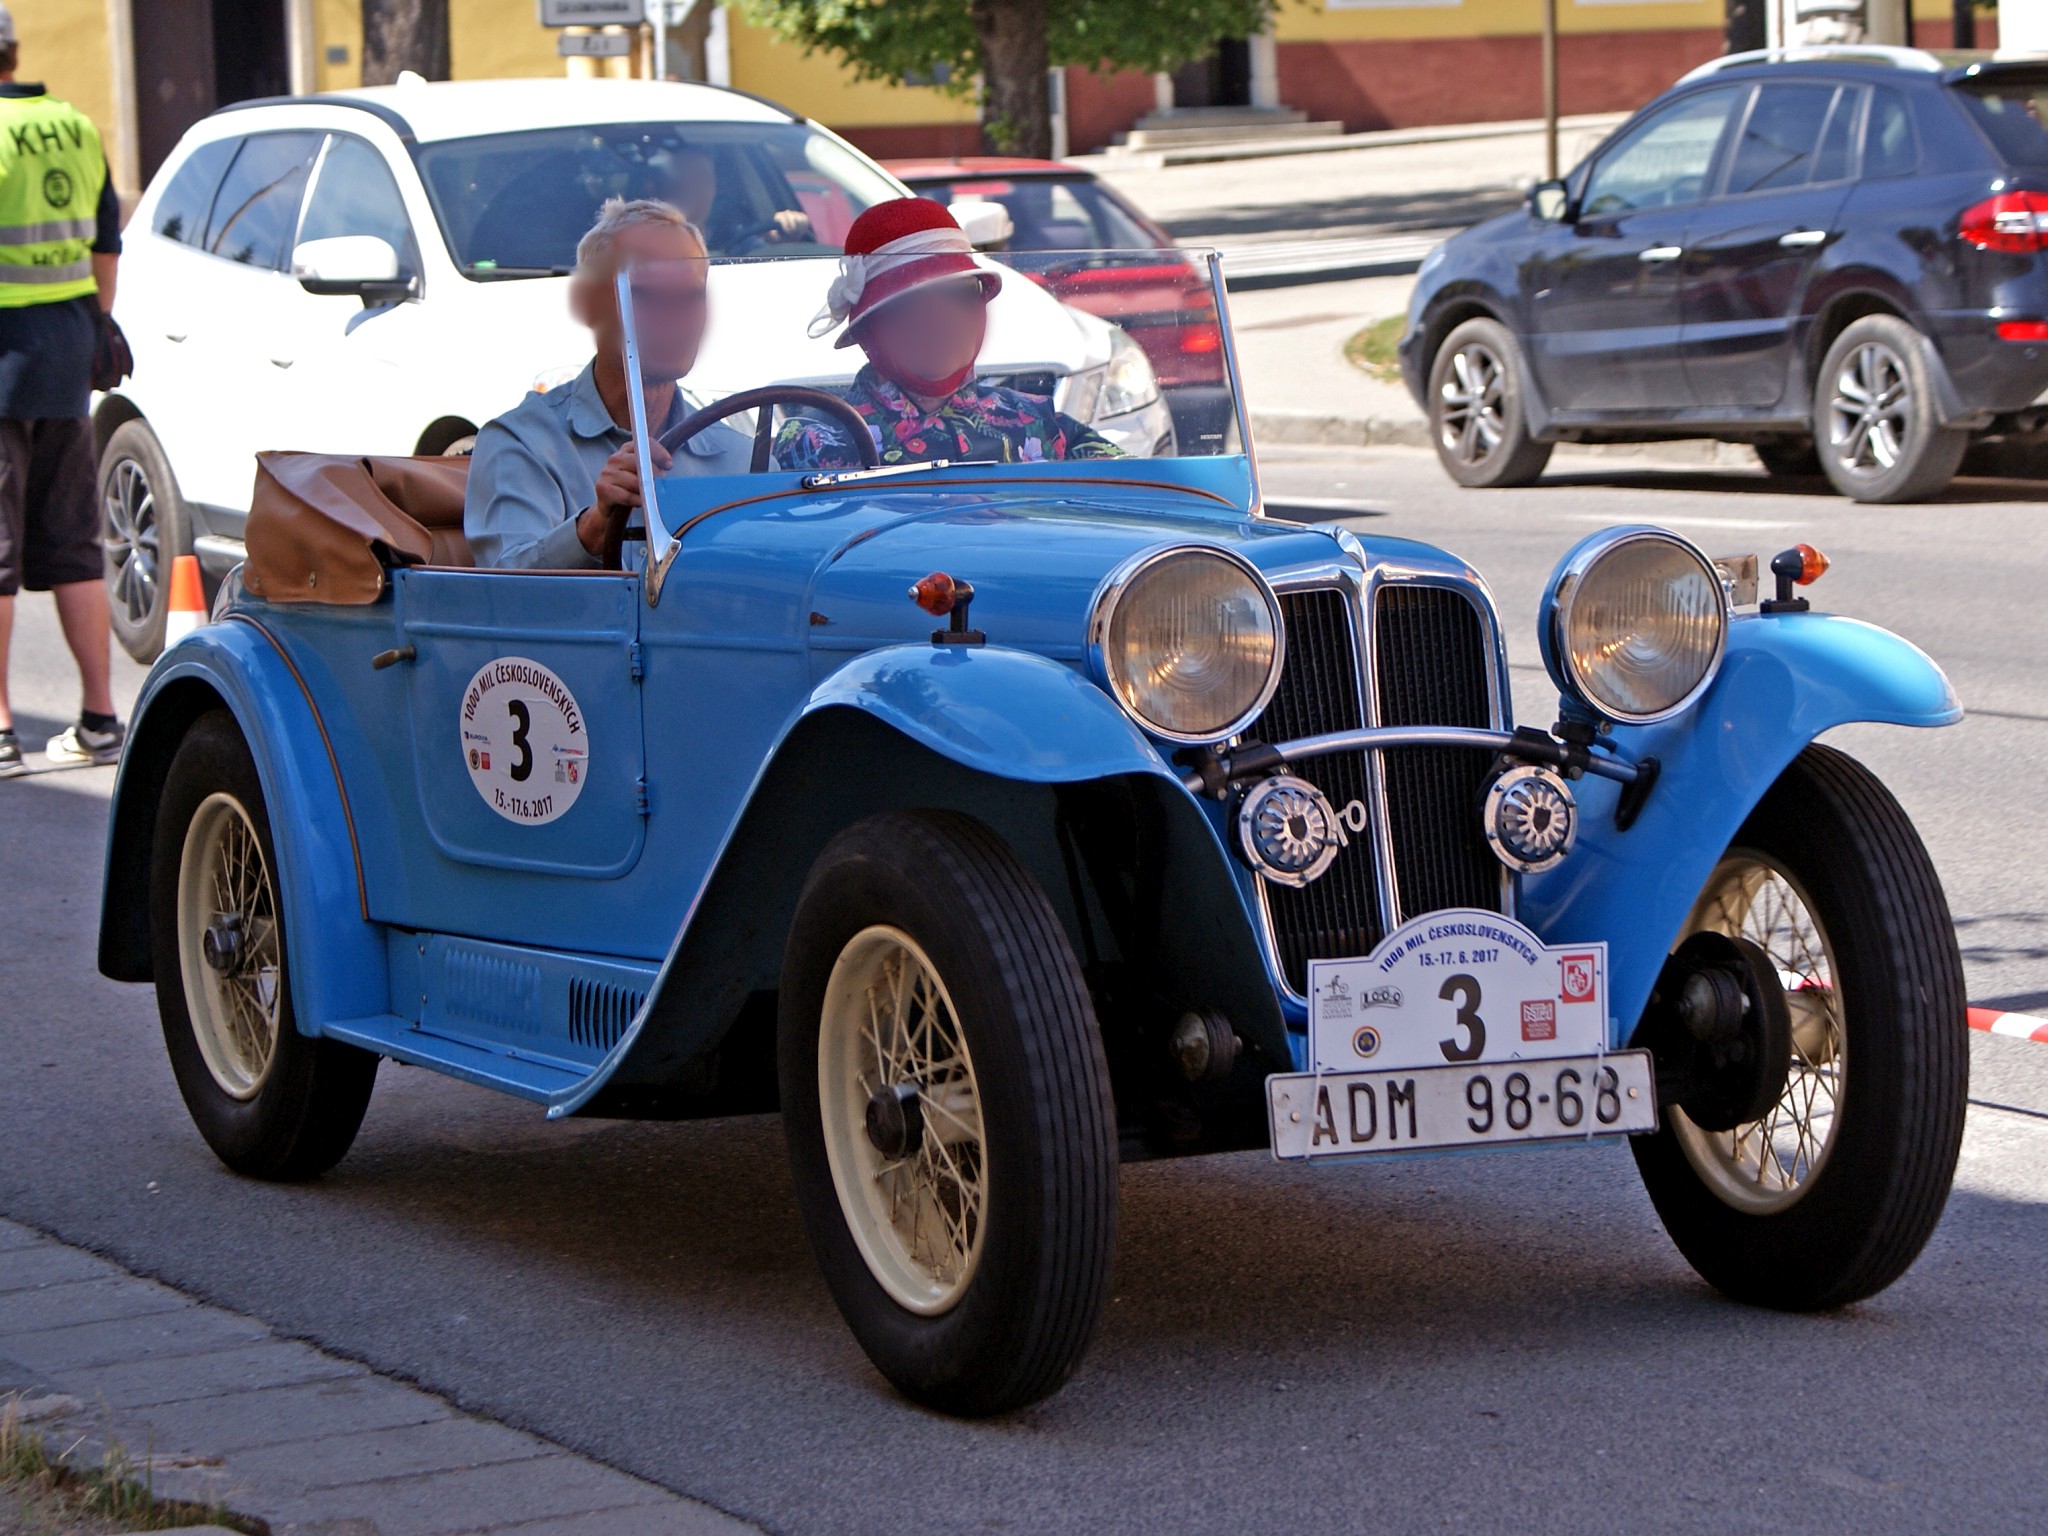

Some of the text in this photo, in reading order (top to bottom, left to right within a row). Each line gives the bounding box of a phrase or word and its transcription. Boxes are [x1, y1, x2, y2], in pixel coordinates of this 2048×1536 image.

[9, 119, 83, 156] KHV
[464, 663, 580, 734] 1000 MIL ČESKOSLOVENSKÝCH
[508, 699, 533, 782] 3
[1379, 923, 1539, 973] 1000 MIL ČESKOSLOVENSKÝCH
[1472, 949, 1499, 963] 2017
[1438, 973, 1486, 1063] 3
[1312, 1065, 1621, 1146] ADM 98-68
